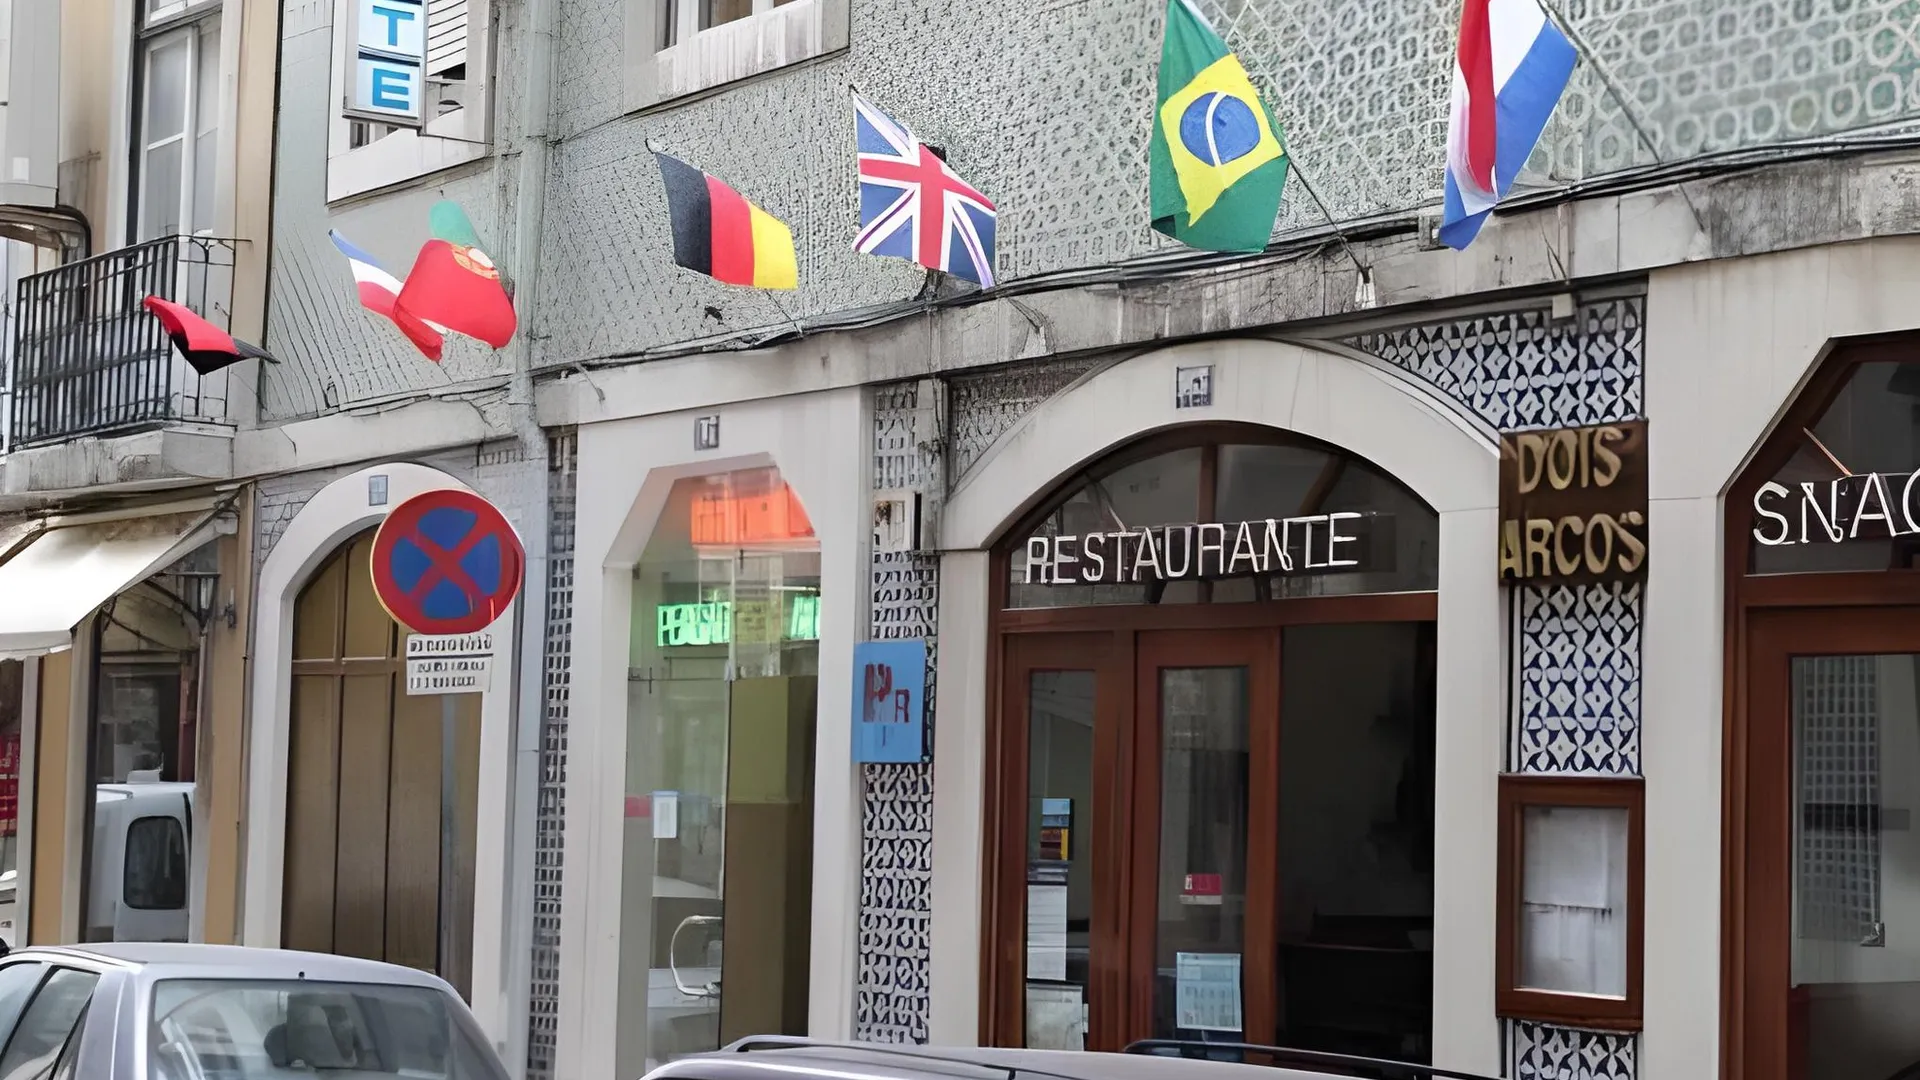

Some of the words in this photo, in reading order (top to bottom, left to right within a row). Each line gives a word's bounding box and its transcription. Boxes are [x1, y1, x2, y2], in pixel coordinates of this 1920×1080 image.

[1516, 426, 1623, 494] DOIS
[1025, 512, 1362, 584] RESTAURANTE
[1500, 511, 1646, 578] ARCOS
